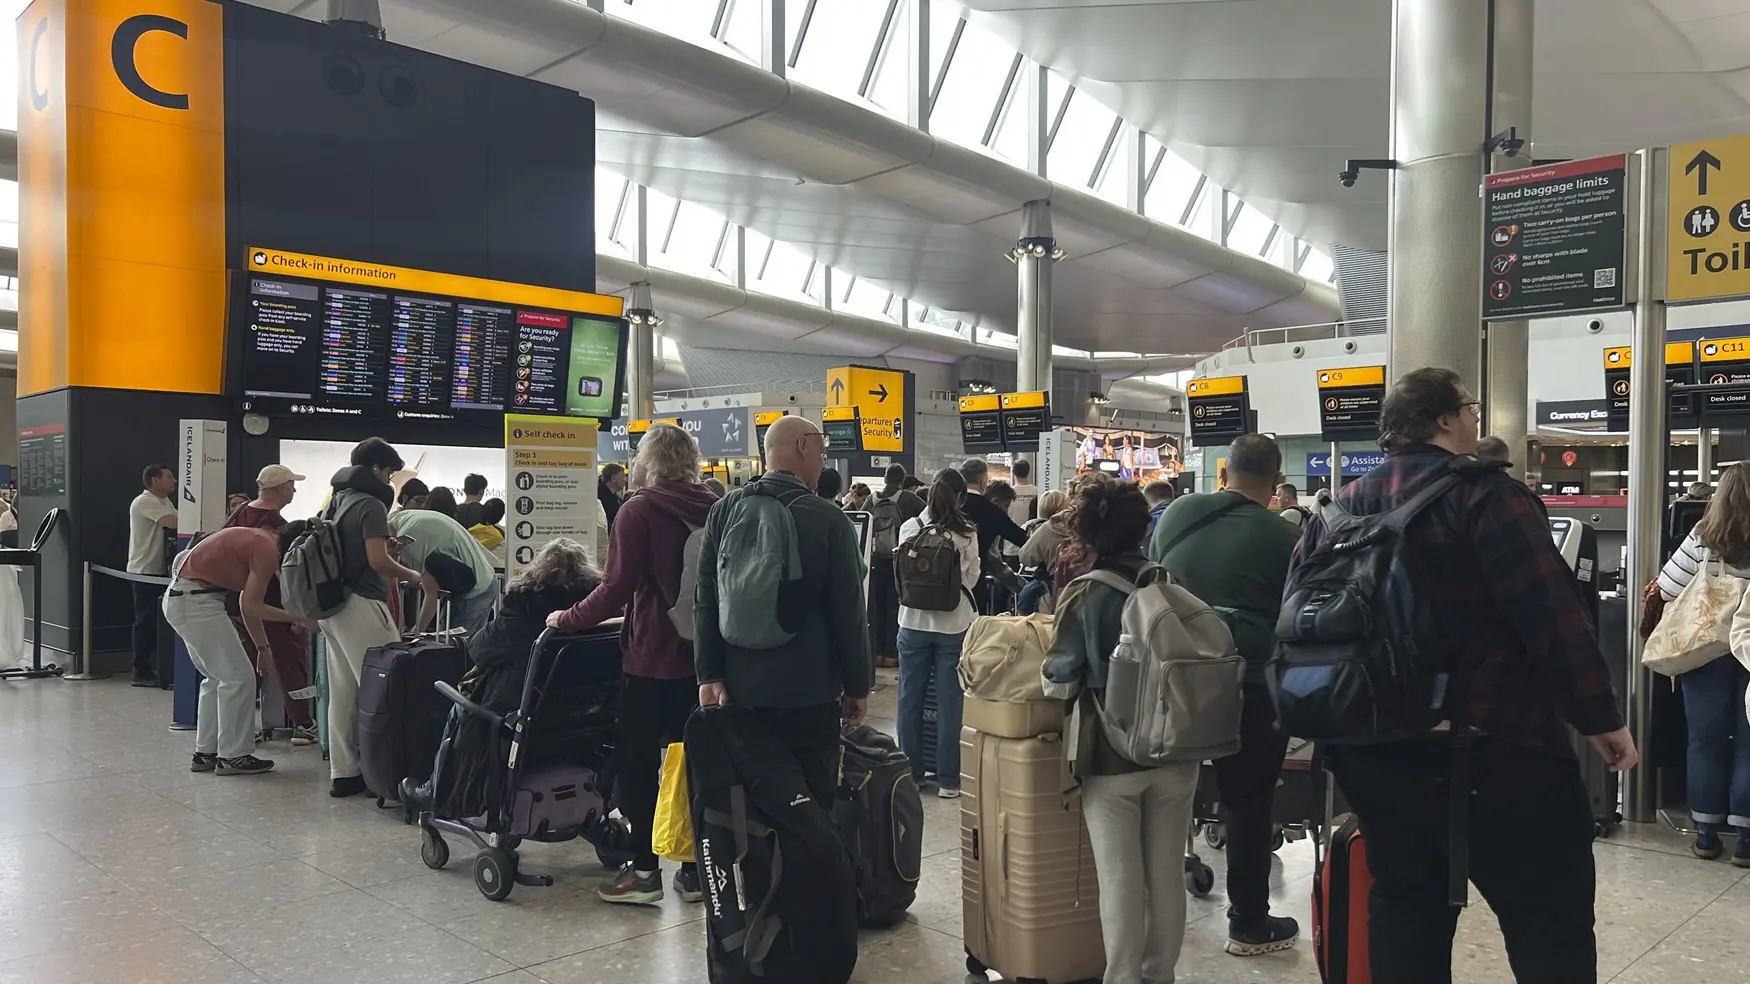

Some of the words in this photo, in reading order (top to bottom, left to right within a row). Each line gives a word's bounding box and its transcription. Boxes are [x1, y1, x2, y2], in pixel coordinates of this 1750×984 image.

[30, 16, 48, 111] C
[111, 14, 189, 110] C
[1497, 176, 1520, 184] Prepare
[1531, 169, 1556, 178] Security
[1492, 189, 1521, 202] Hand
[1524, 181, 1574, 197] baggage
[1576, 176, 1609, 189] limits
[1592, 188, 1616, 197] luggage
[1510, 206, 1534, 214] checking
[1538, 217, 1564, 227] carry-on
[1565, 214, 1580, 223] bags
[1582, 213, 1593, 221] per
[1594, 210, 1616, 220] person
[1683, 242, 1750, 275] Toil
[272, 254, 324, 271] Check-in
[328, 260, 396, 280] information
[1532, 273, 1564, 283] prohibited
[529, 334, 555, 343] Security?
[1722, 342, 1744, 352] C11
[1625, 351, 1631, 359] C
[1550, 411, 1590, 420] Currency
[1590, 410, 1608, 418] Exc
[682, 421, 701, 432] YOU
[860, 418, 892, 426] epartures
[864, 427, 892, 438] Security
[613, 441, 629, 450] WIT
[1351, 456, 1385, 464] Assista
[702, 838, 722, 916] Kathmandu
